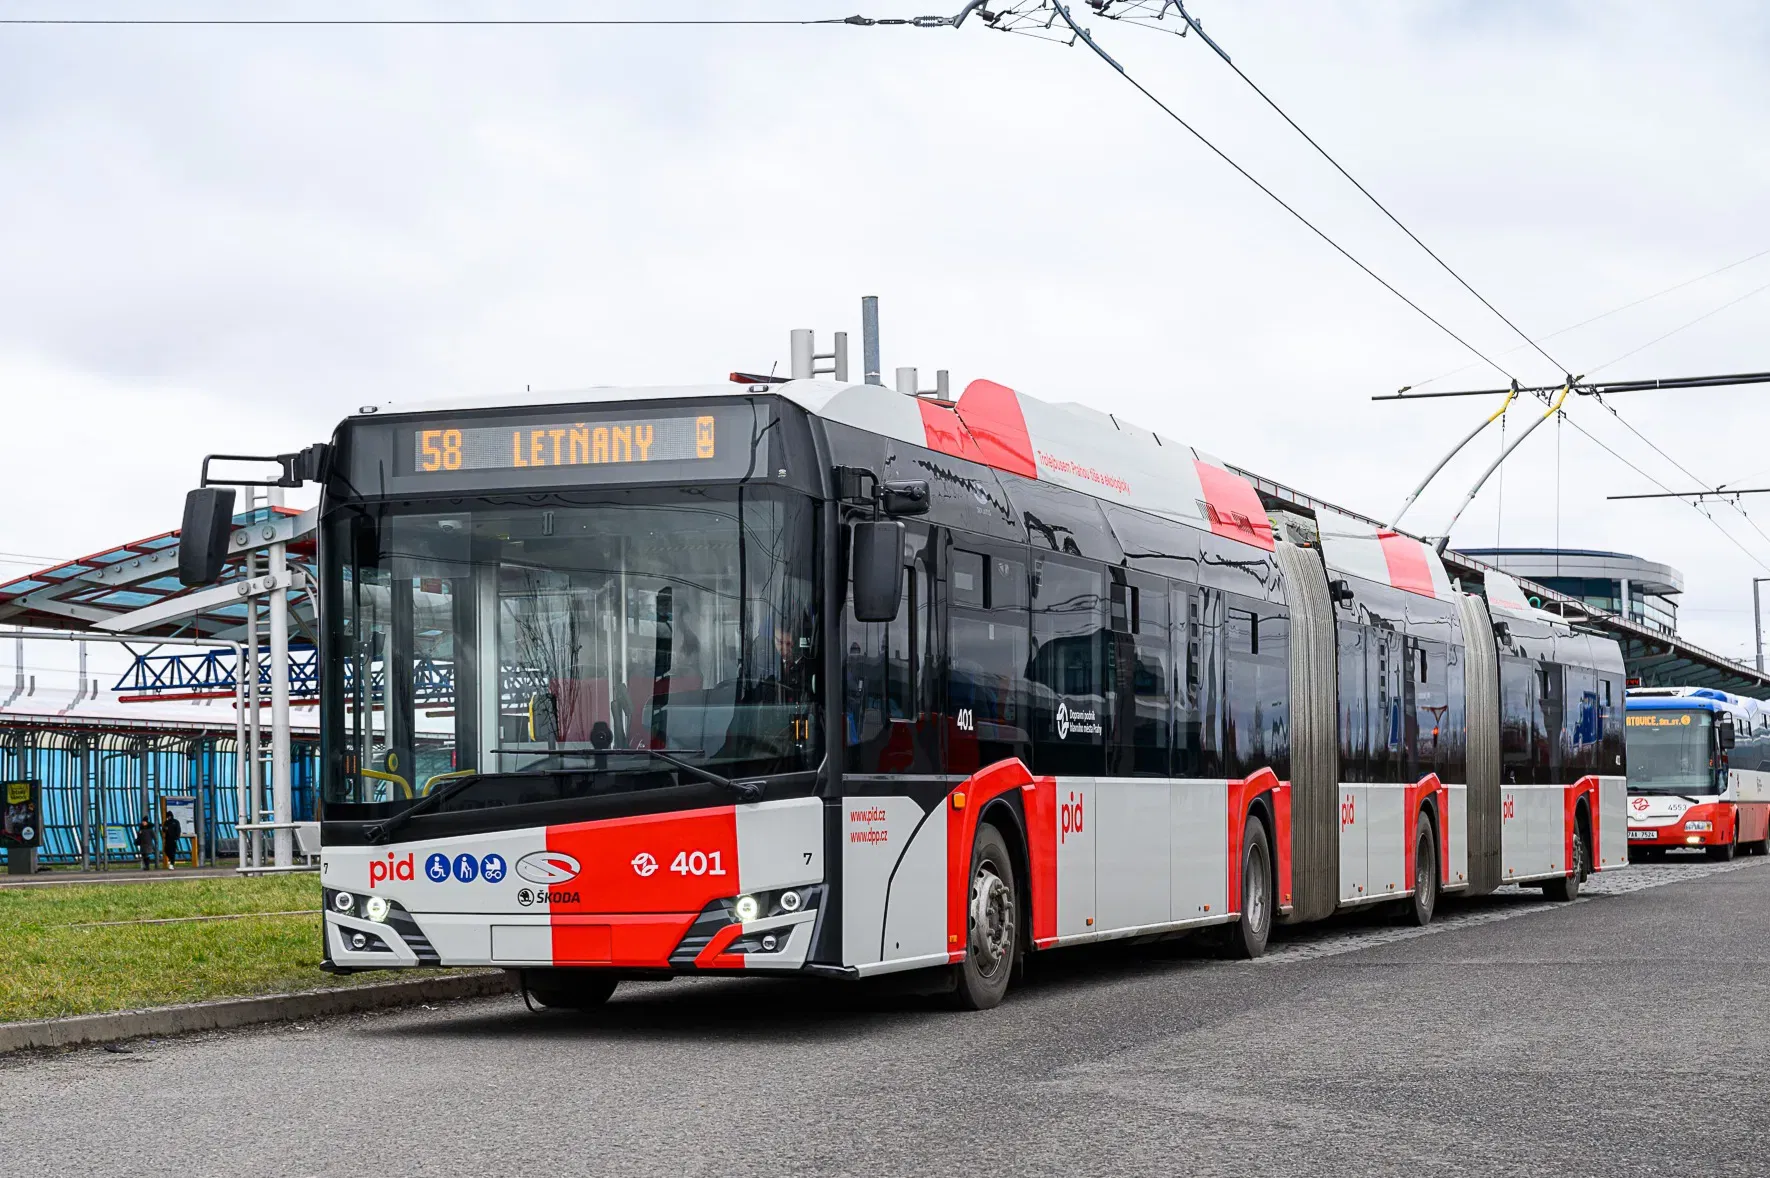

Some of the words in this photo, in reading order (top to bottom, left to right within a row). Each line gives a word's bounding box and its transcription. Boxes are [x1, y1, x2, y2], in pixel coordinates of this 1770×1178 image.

[422, 429, 462, 471] 58
[513, 422, 653, 468] LETŇANY
[1071, 461, 1090, 480] Prahou
[957, 708, 974, 731] 401
[850, 806, 886, 825] www.pid.cz
[1062, 791, 1083, 844] pid
[1342, 794, 1354, 832] pid
[1504, 794, 1514, 825] pid
[850, 827, 888, 846] www.dpp.cz
[323, 862, 328, 874] 7
[369, 852, 415, 888] pid
[669, 851, 726, 876] 401
[803, 852, 812, 866] 7
[536, 890, 581, 904] ŠKODA
